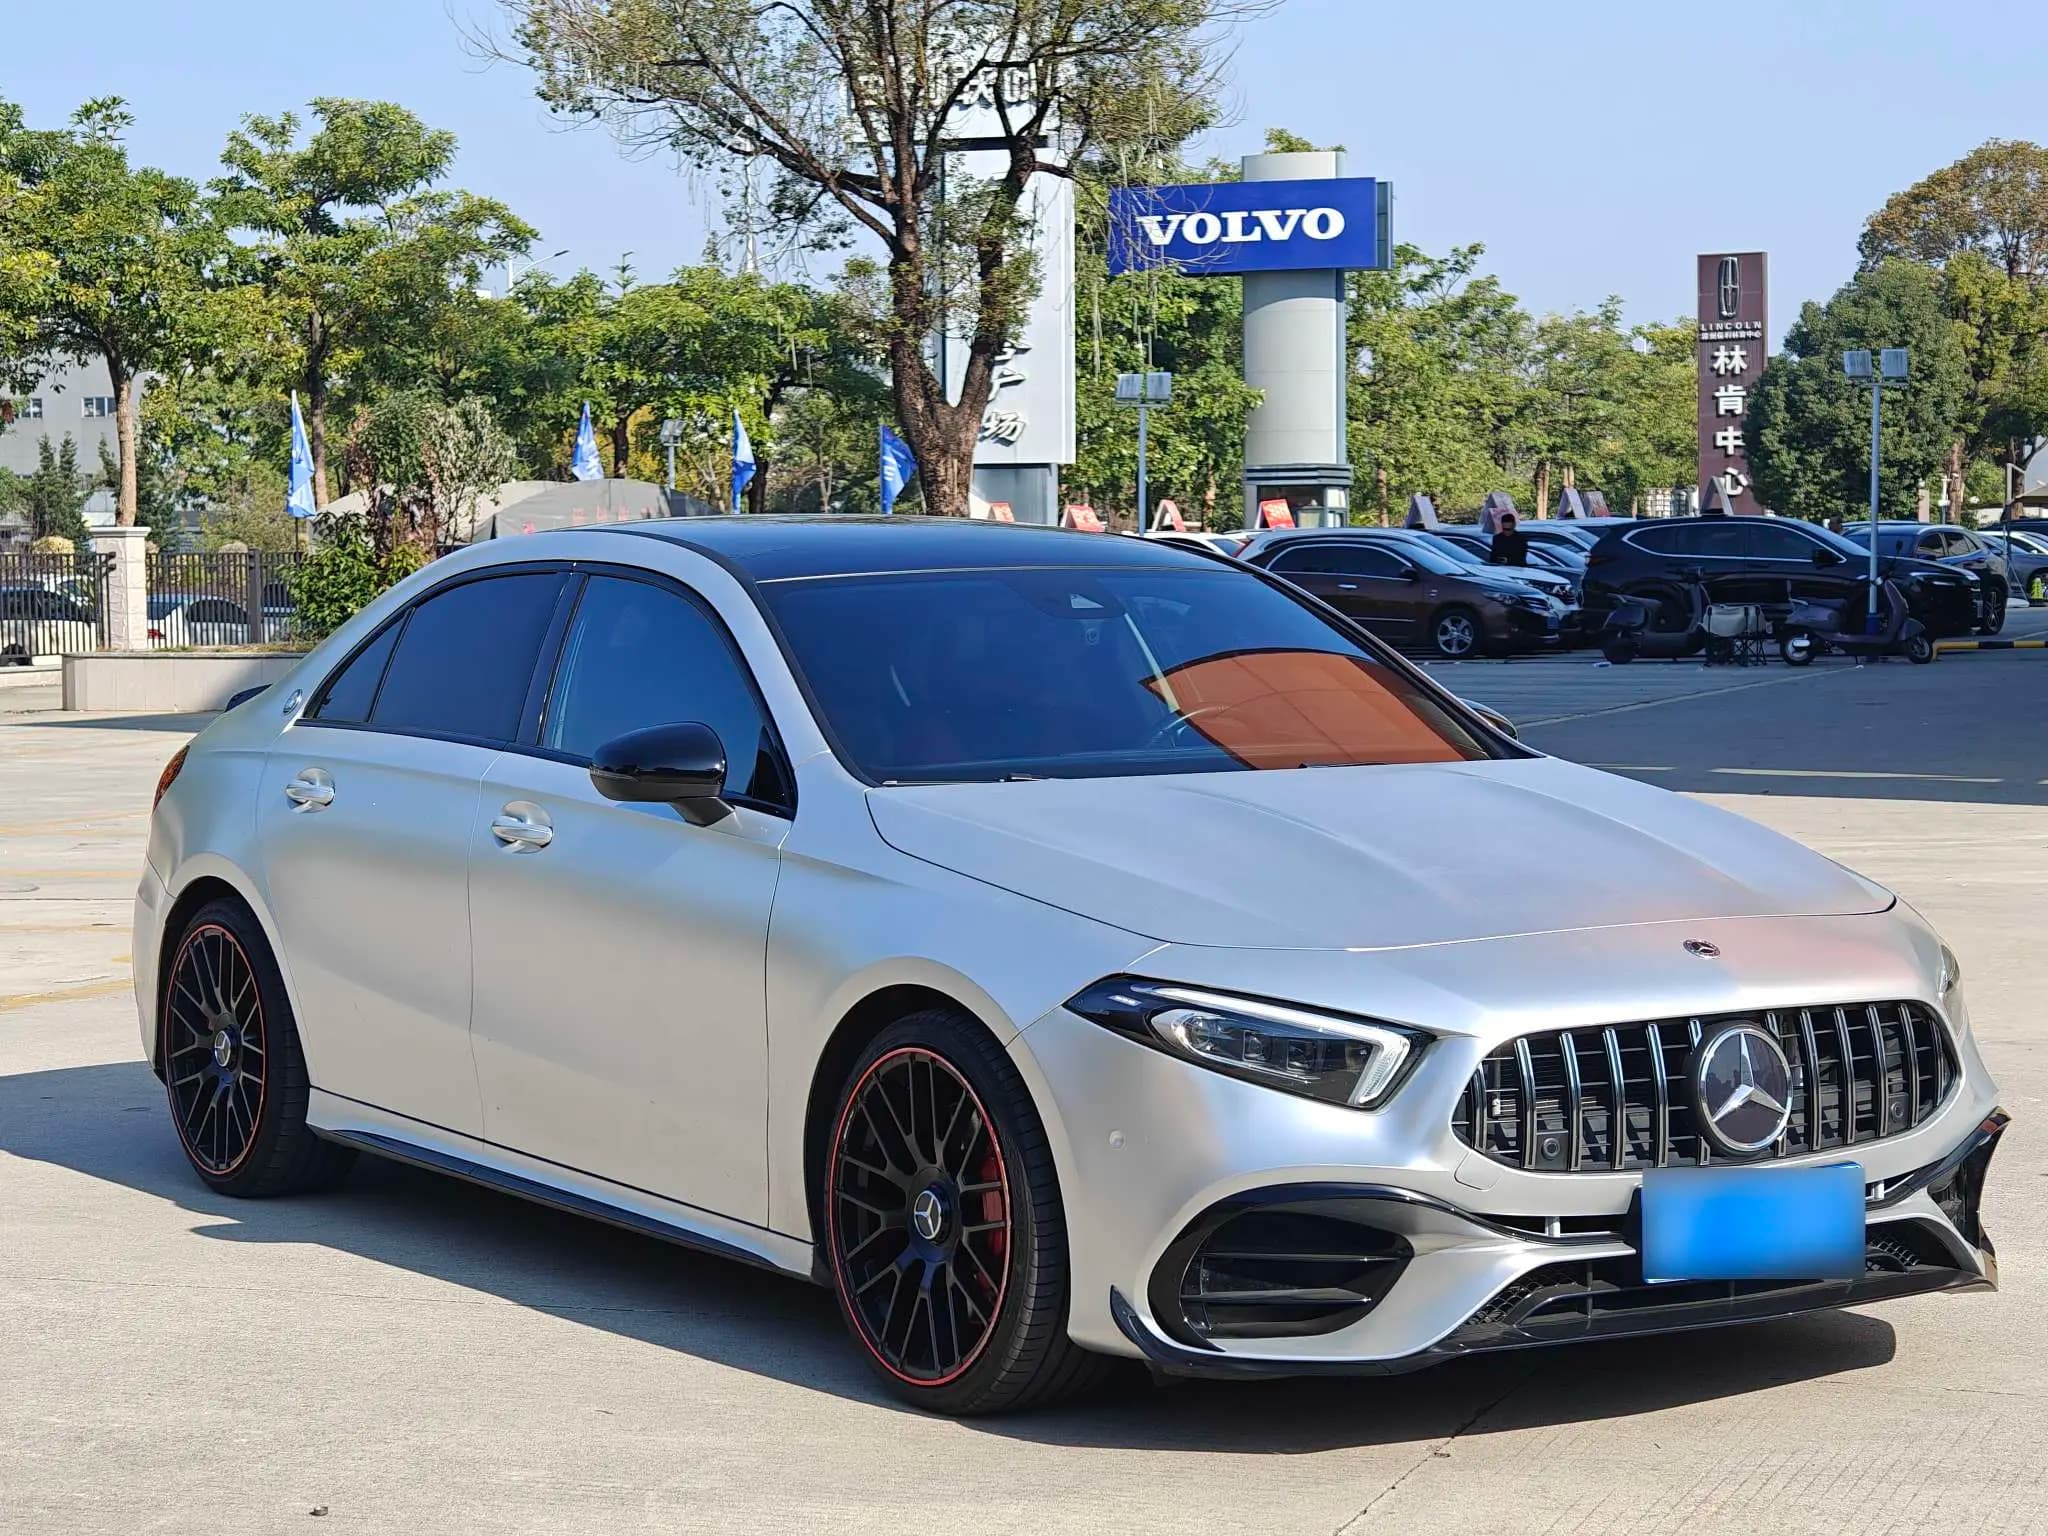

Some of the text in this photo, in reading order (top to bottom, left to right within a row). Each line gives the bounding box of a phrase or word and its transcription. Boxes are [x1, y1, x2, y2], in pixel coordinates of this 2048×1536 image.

[1135, 207, 1345, 245] VOLVO
[1701, 321, 1762, 331] LINCOLN
[1712, 344, 1748, 496] 林肯中心
